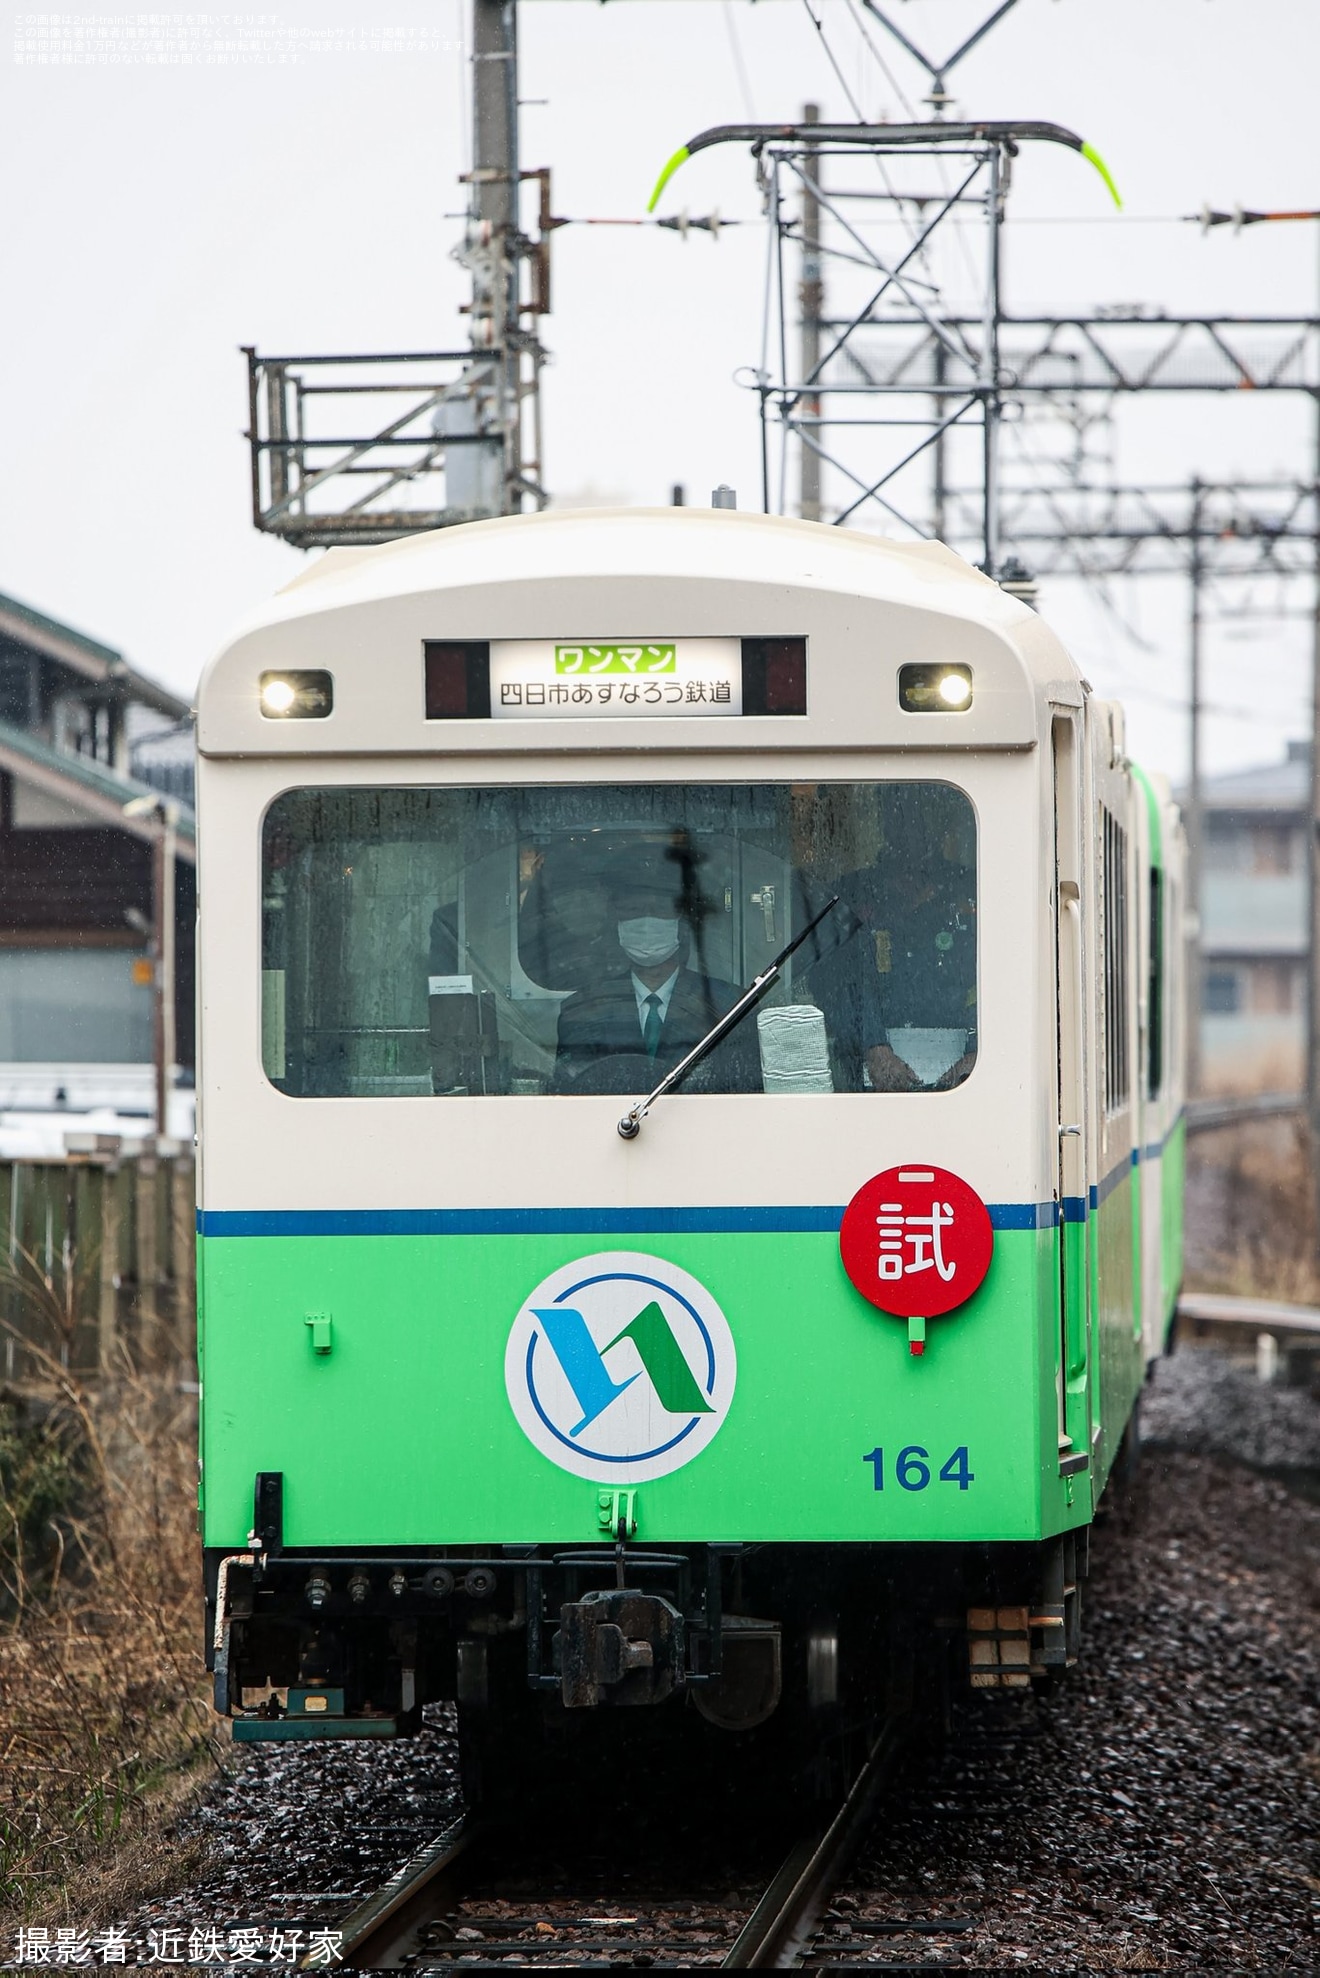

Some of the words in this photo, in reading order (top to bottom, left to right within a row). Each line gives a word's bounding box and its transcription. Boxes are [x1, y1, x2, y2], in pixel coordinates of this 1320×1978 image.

[557, 646, 674, 673] ワンマン
[500, 680, 732, 706] 四日市あすなろう鉄道
[876, 1201, 957, 1282] 試
[862, 1446, 975, 1492] 164
